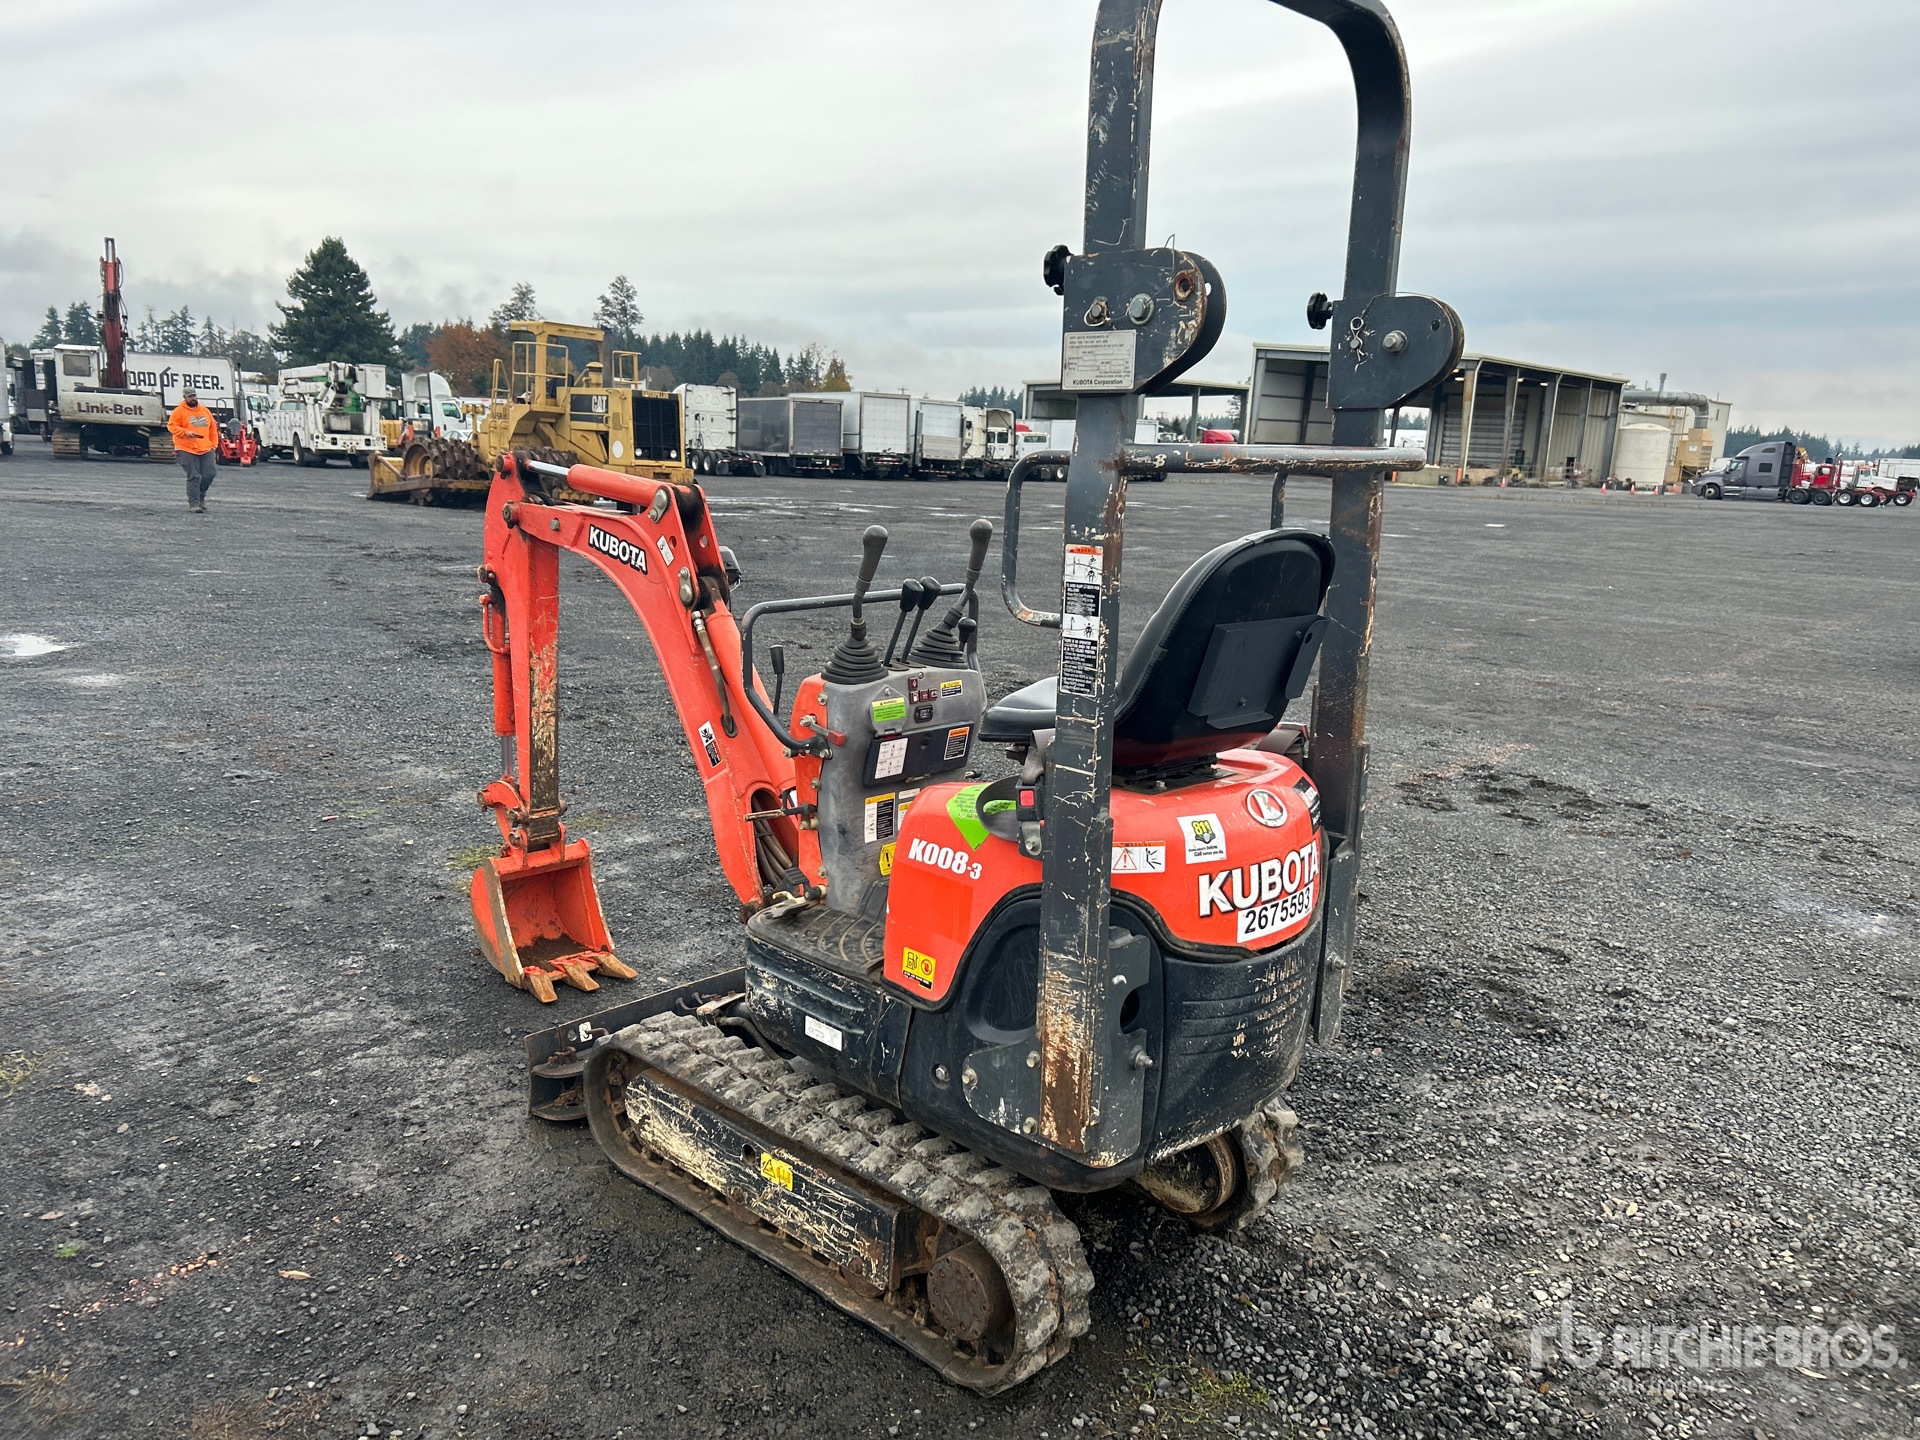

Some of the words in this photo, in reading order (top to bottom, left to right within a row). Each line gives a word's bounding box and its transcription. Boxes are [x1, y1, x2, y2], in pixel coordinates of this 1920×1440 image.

[182, 373, 225, 391] BEER.
[77, 402, 144, 416] Link-Belt
[592, 395, 607, 413] CAT
[589, 525, 647, 572] KUBOTA
[908, 838, 983, 880] K008-3
[1198, 841, 1319, 917] KUBOTA
[1244, 887, 1311, 935] 2675593
